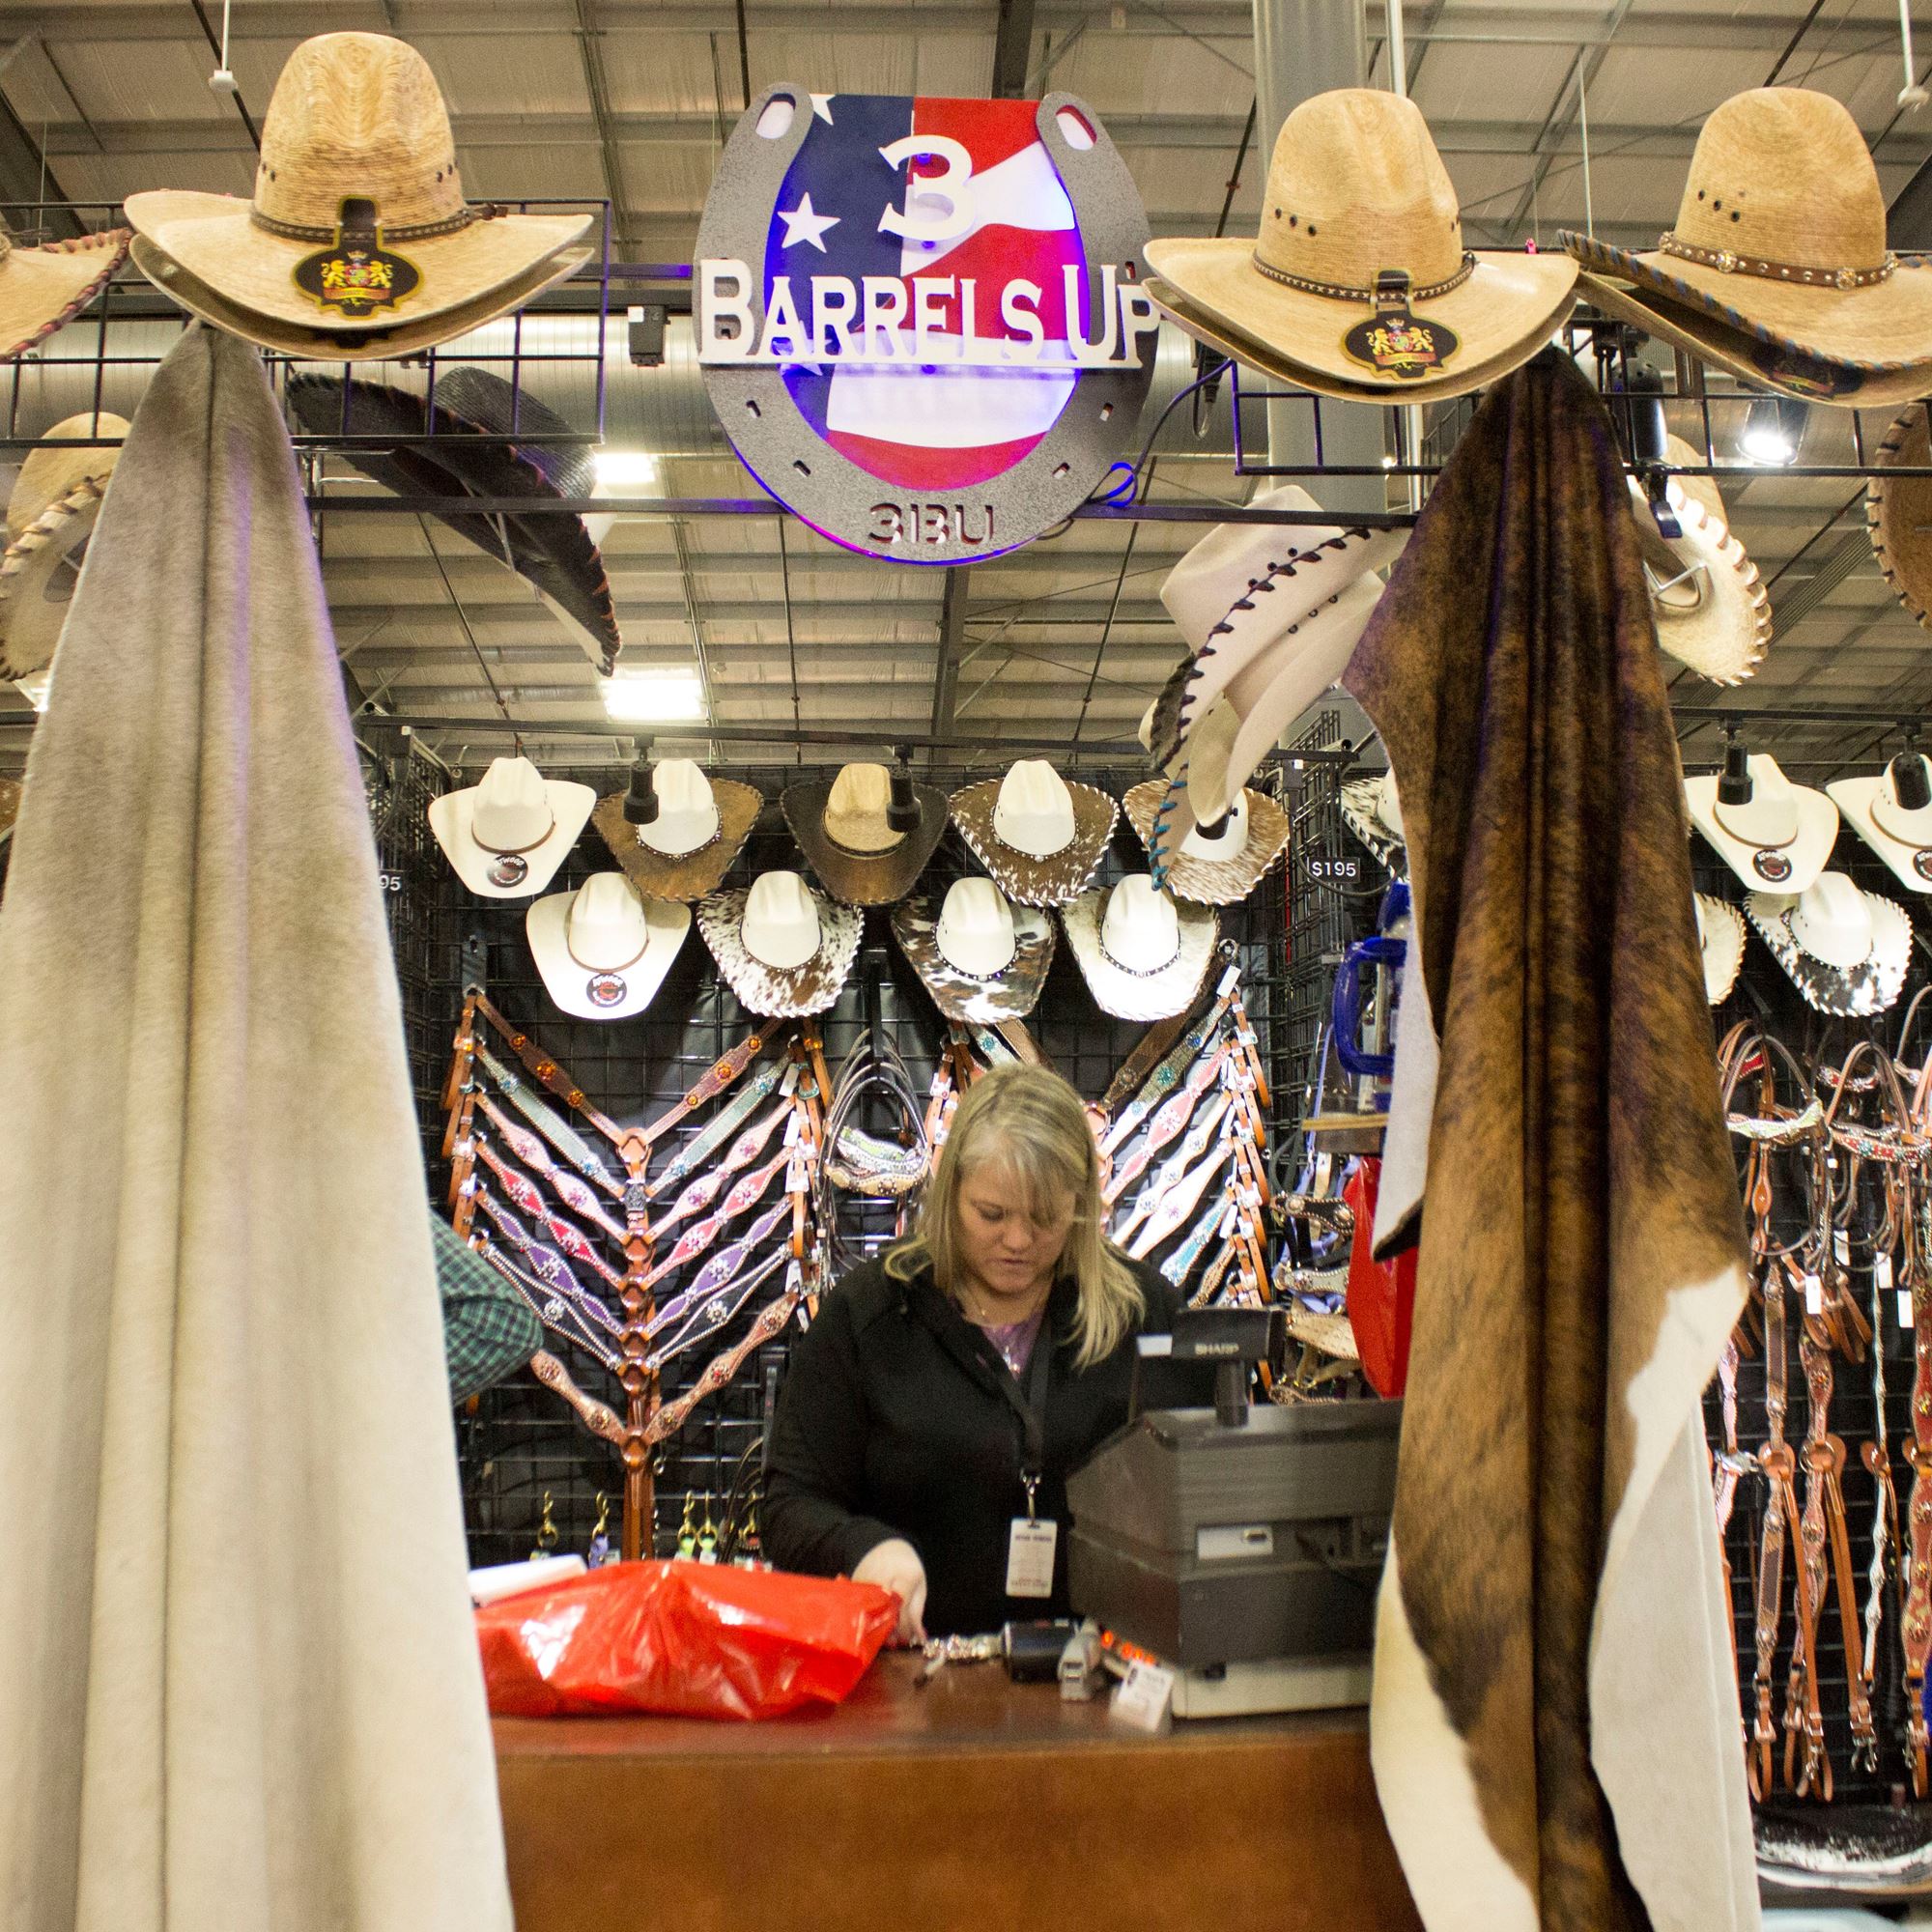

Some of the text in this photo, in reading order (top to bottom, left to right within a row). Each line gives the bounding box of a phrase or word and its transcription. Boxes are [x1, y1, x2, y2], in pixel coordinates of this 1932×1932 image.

[878, 134, 974, 241] 3
[698, 259, 1161, 367] BARRELS UP
[868, 502, 994, 545] 3BU
[1312, 862, 1356, 876] $195
